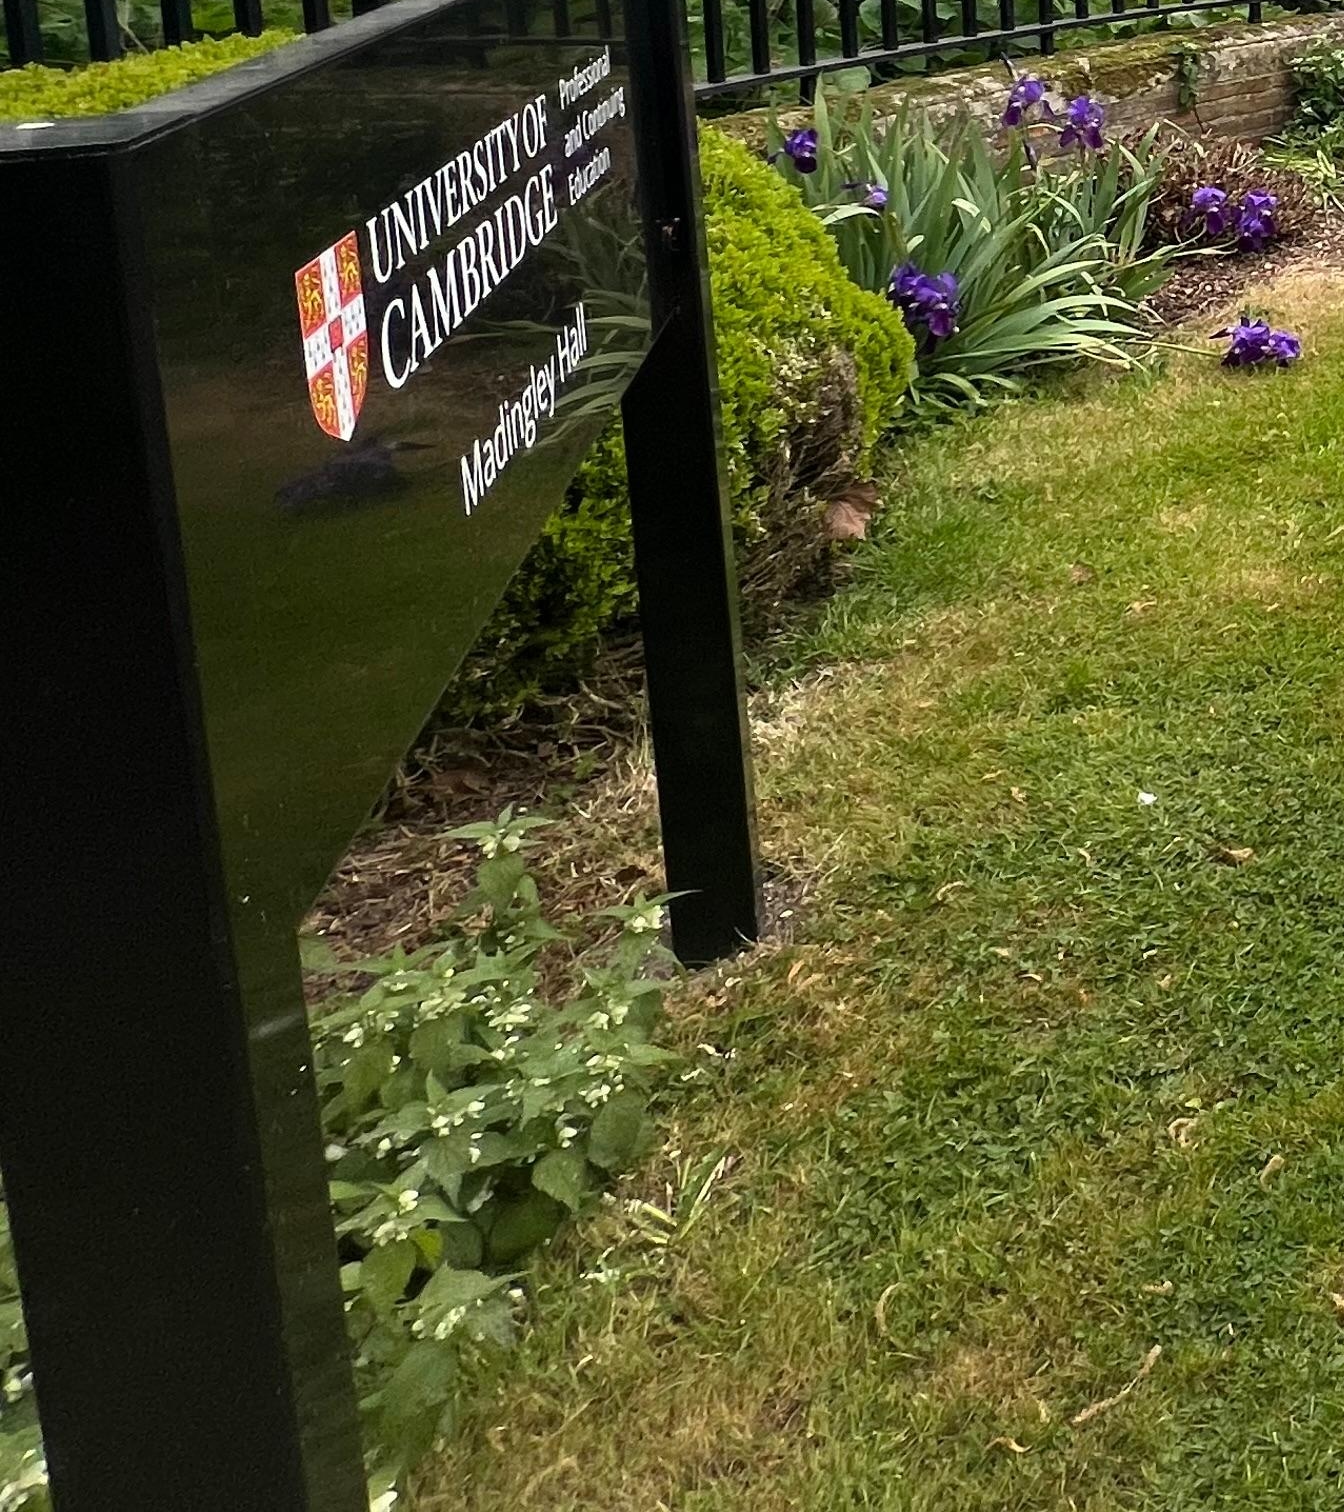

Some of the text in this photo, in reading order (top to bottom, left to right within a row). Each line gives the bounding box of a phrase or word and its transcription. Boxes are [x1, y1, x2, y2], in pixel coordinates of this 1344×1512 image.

[366, 94, 548, 284] UNIVERSITY OF
[565, 115, 583, 158] and
[568, 147, 611, 206] Education
[381, 163, 558, 389] CAMBRIDGE
[460, 302, 589, 517] Madingley Hall
